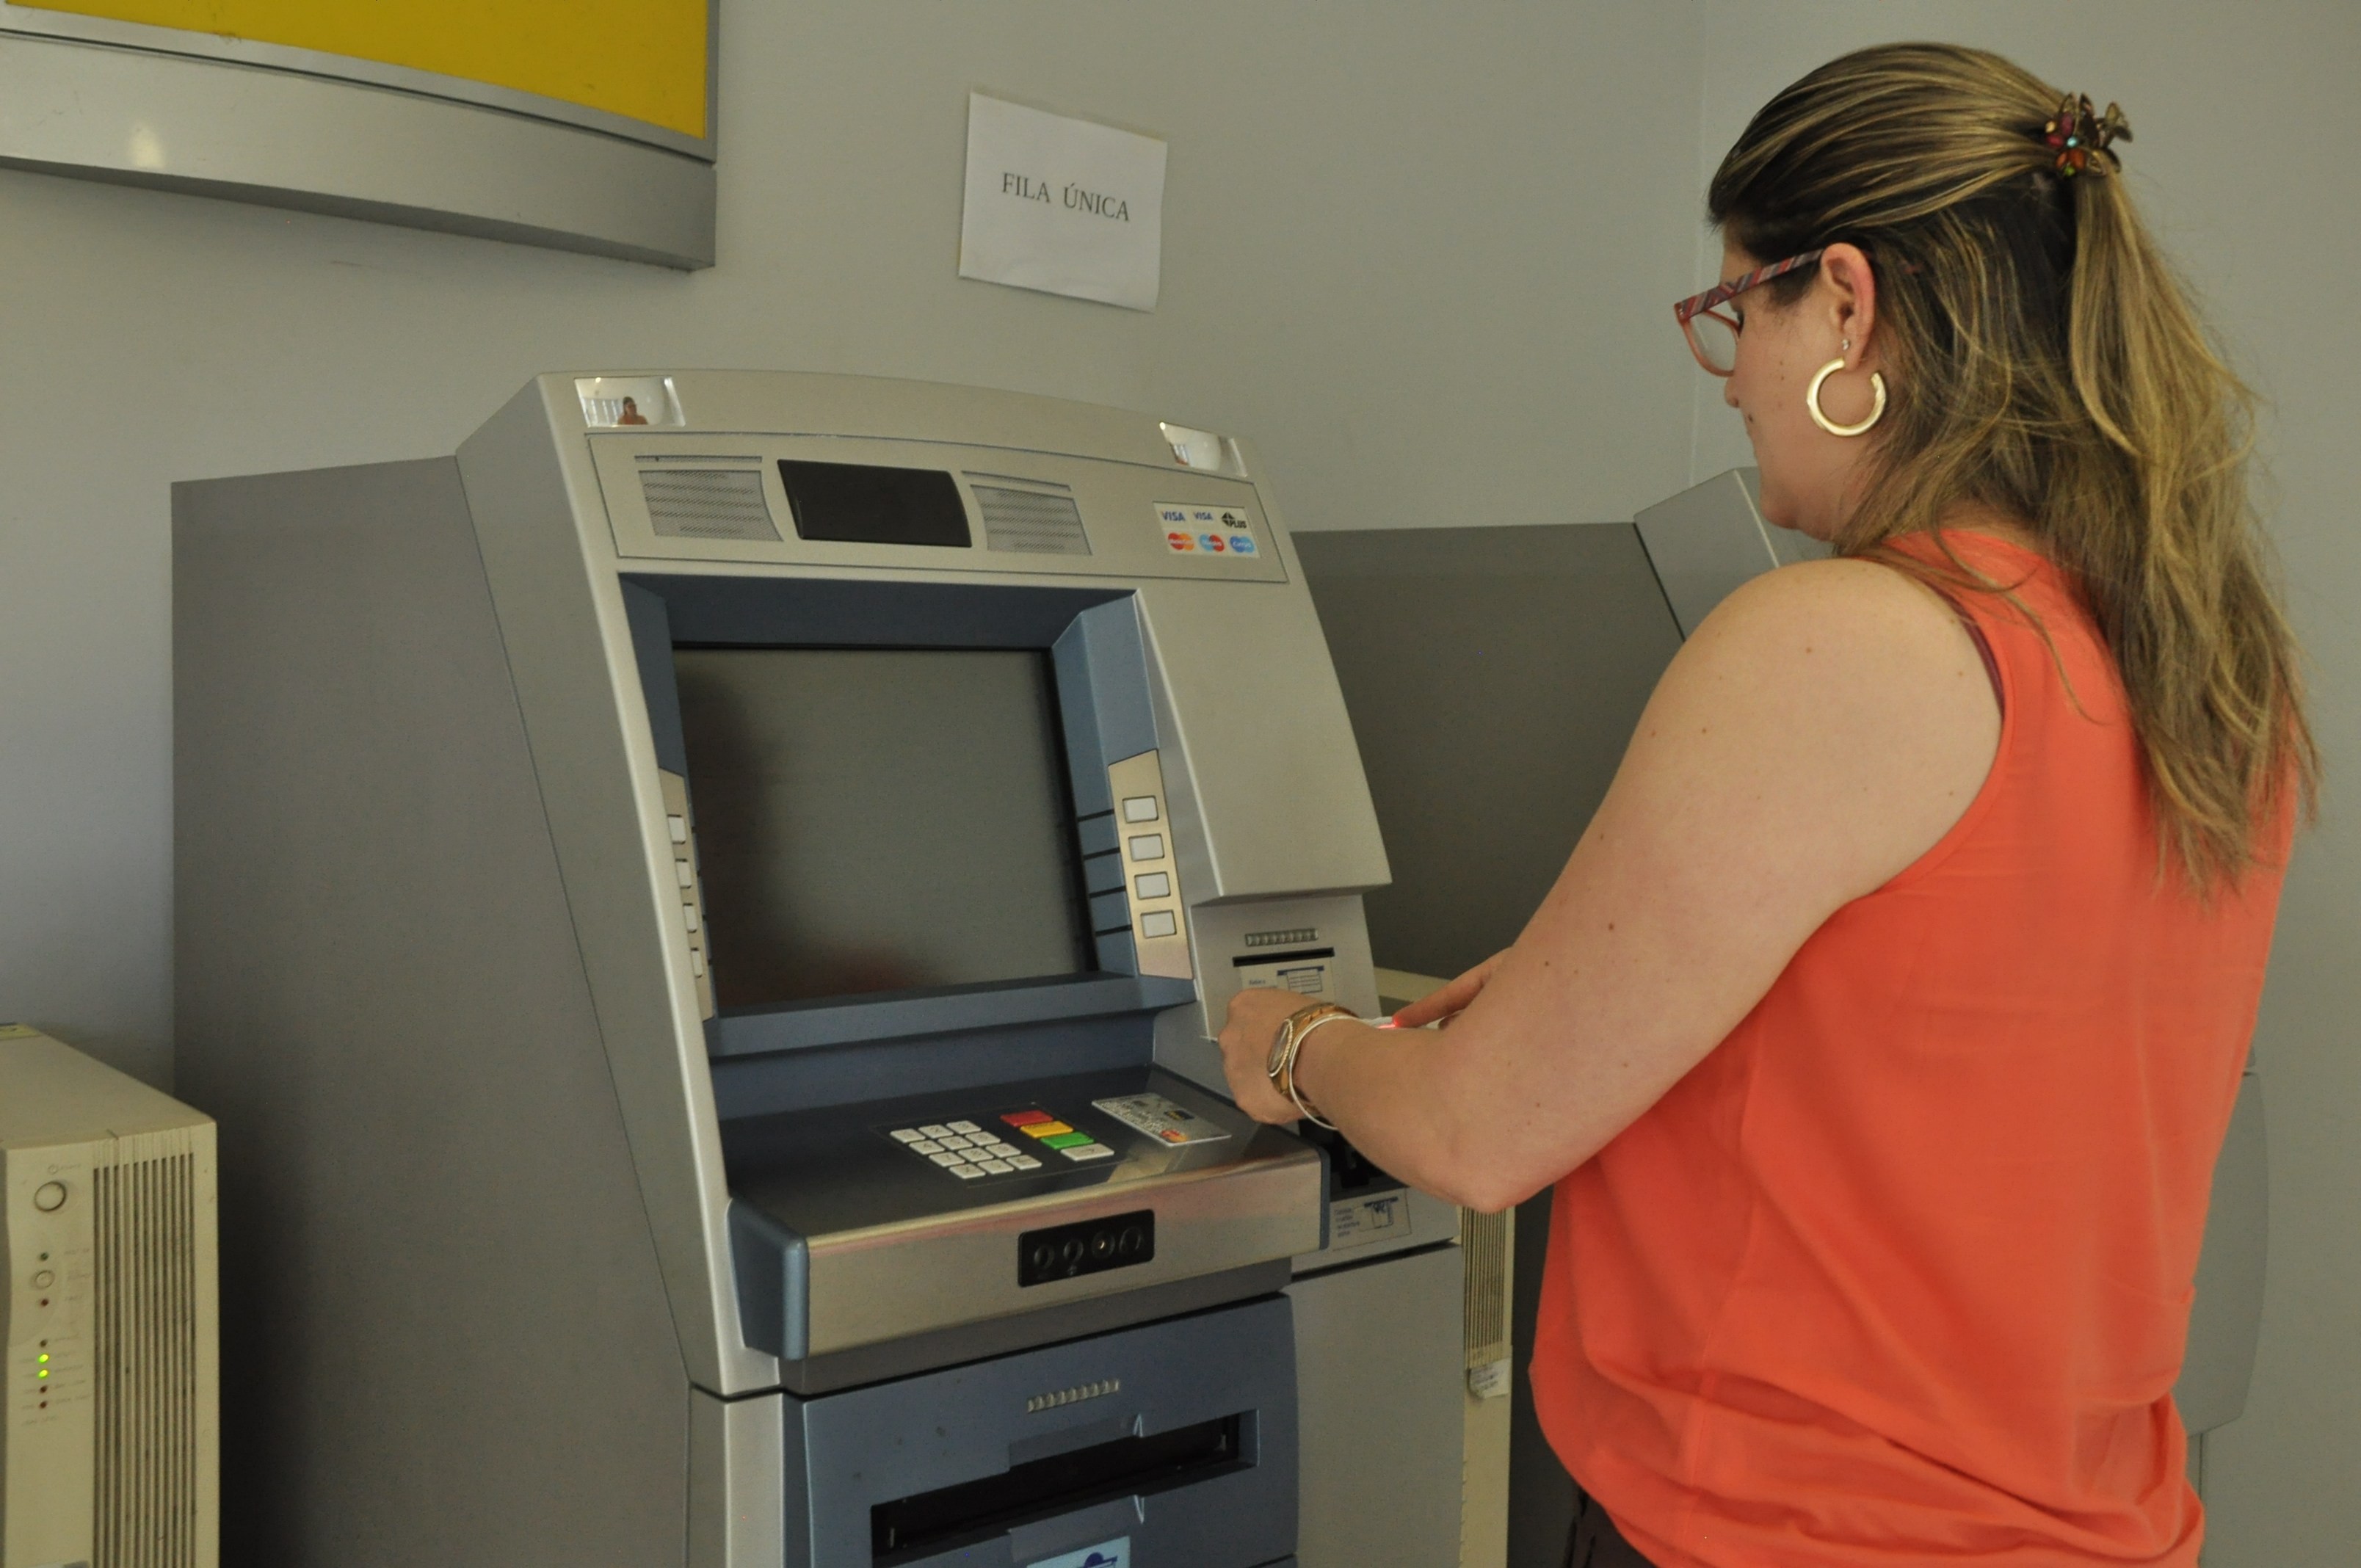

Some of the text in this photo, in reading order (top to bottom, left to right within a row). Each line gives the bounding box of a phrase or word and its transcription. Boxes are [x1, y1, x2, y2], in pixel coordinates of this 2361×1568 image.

[1002, 173, 1130, 222] FILA ÚNICA
[1161, 512, 1186, 521] VISA
[1193, 512, 1213, 520] VISA
[1229, 520, 1247, 529] PLUS
